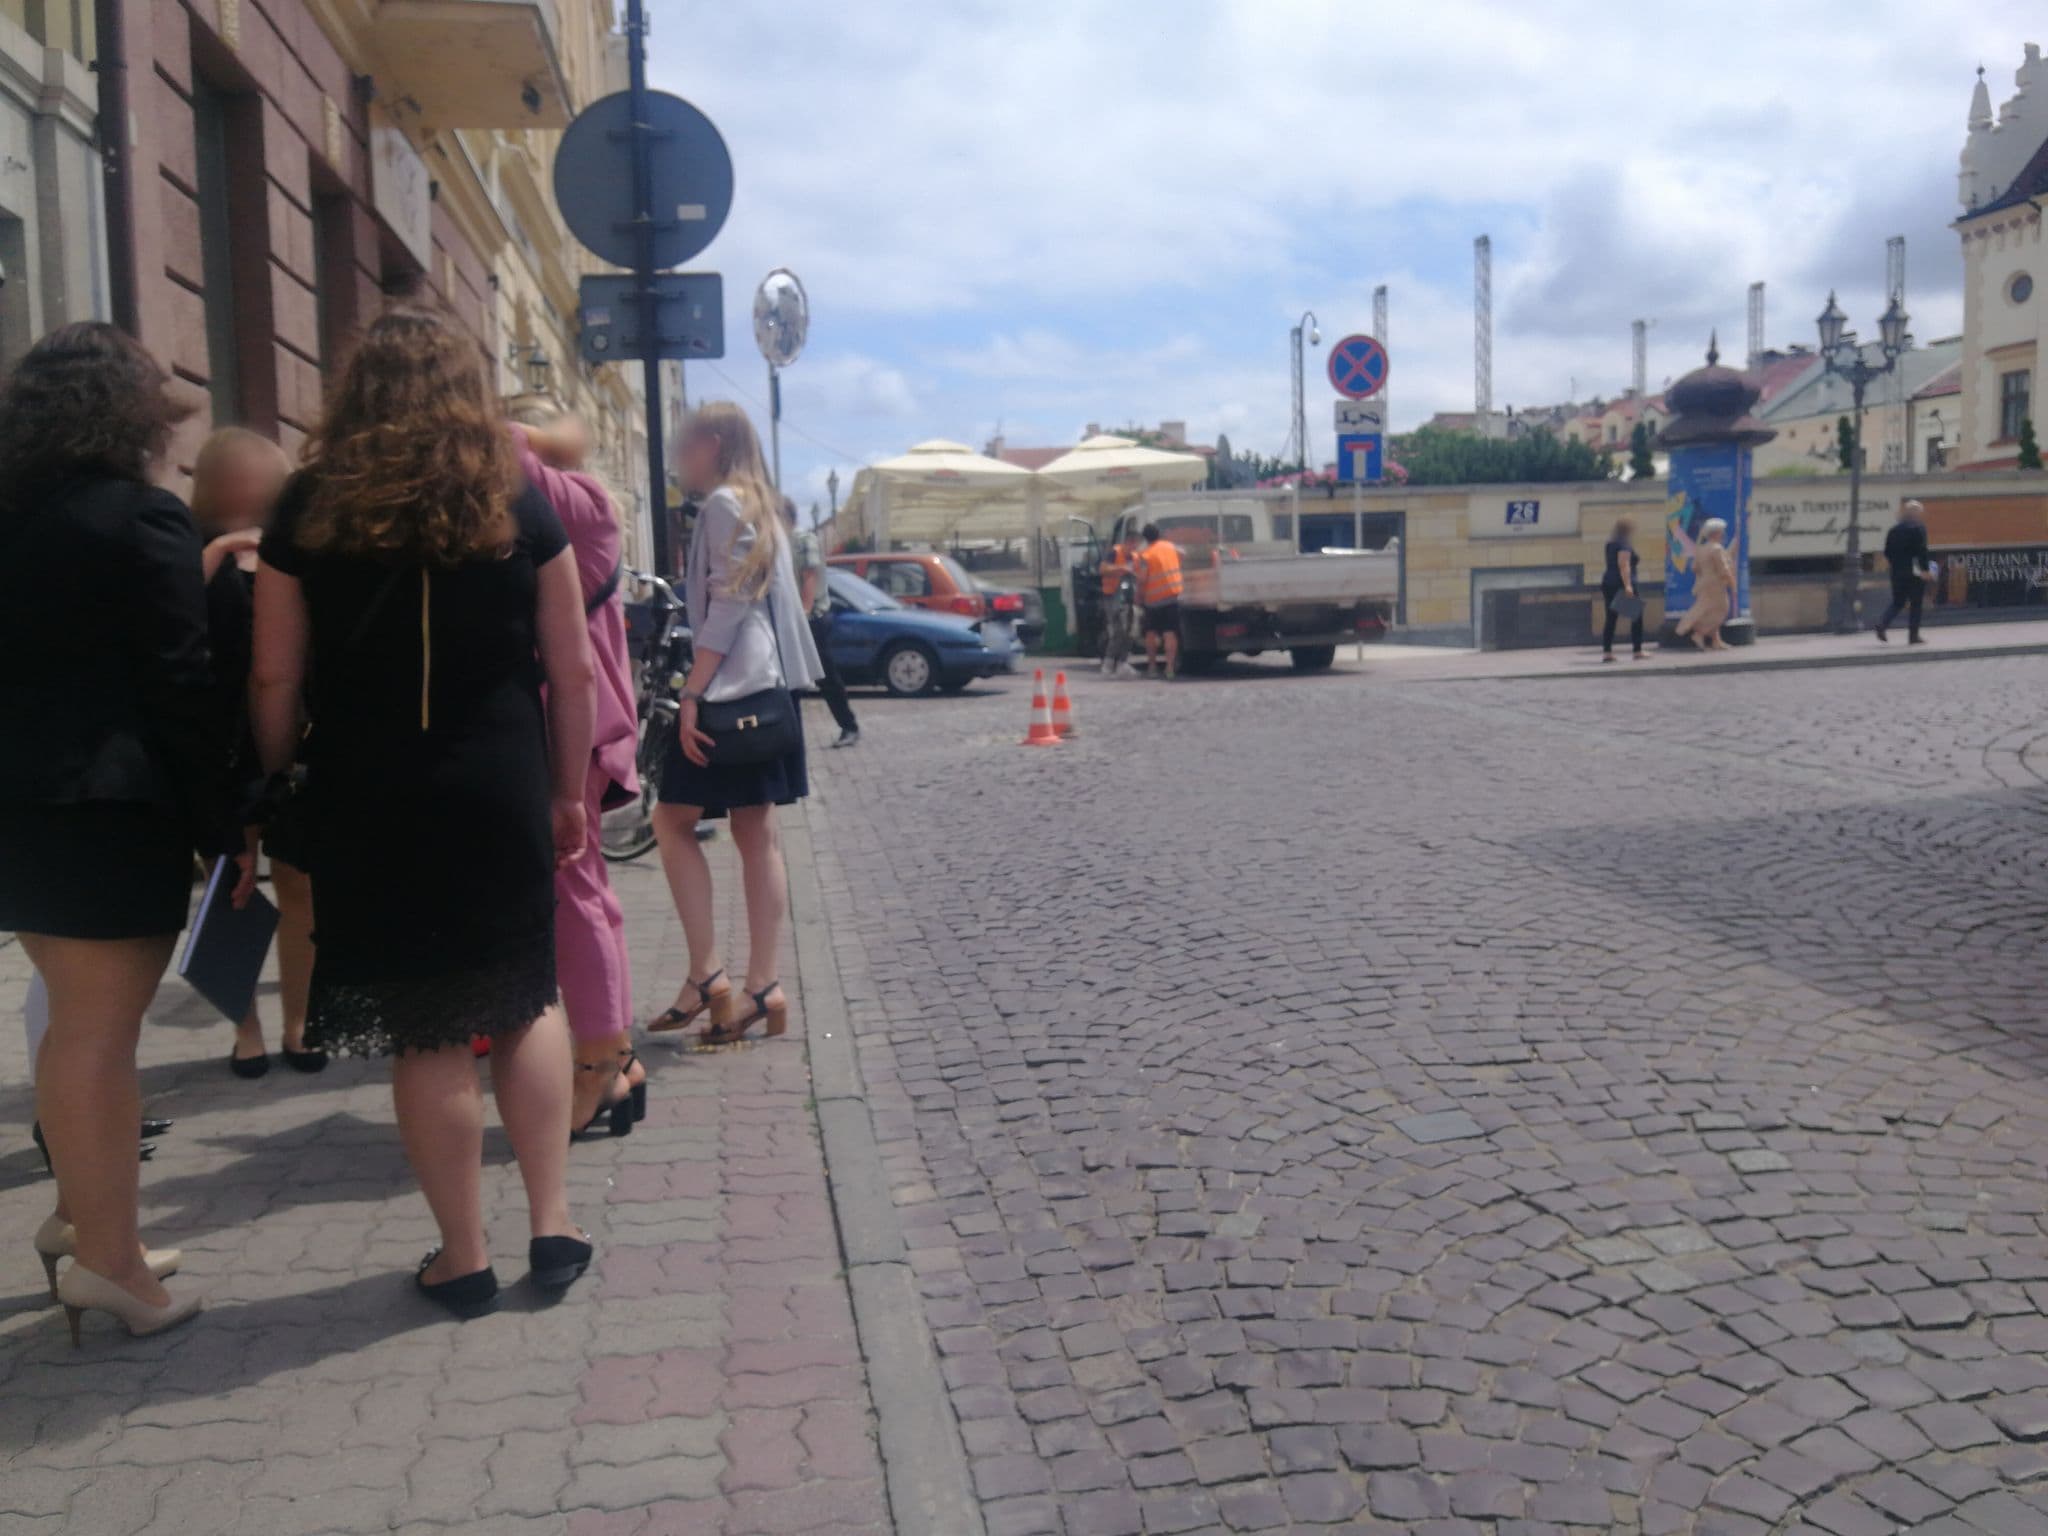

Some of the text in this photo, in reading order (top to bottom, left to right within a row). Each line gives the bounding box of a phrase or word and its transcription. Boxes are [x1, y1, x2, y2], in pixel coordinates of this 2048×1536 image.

[1511, 503, 1534, 520] 26
[1802, 500, 1889, 513] TURYSTCZNA
[1968, 567, 2048, 583] TURYSTY
